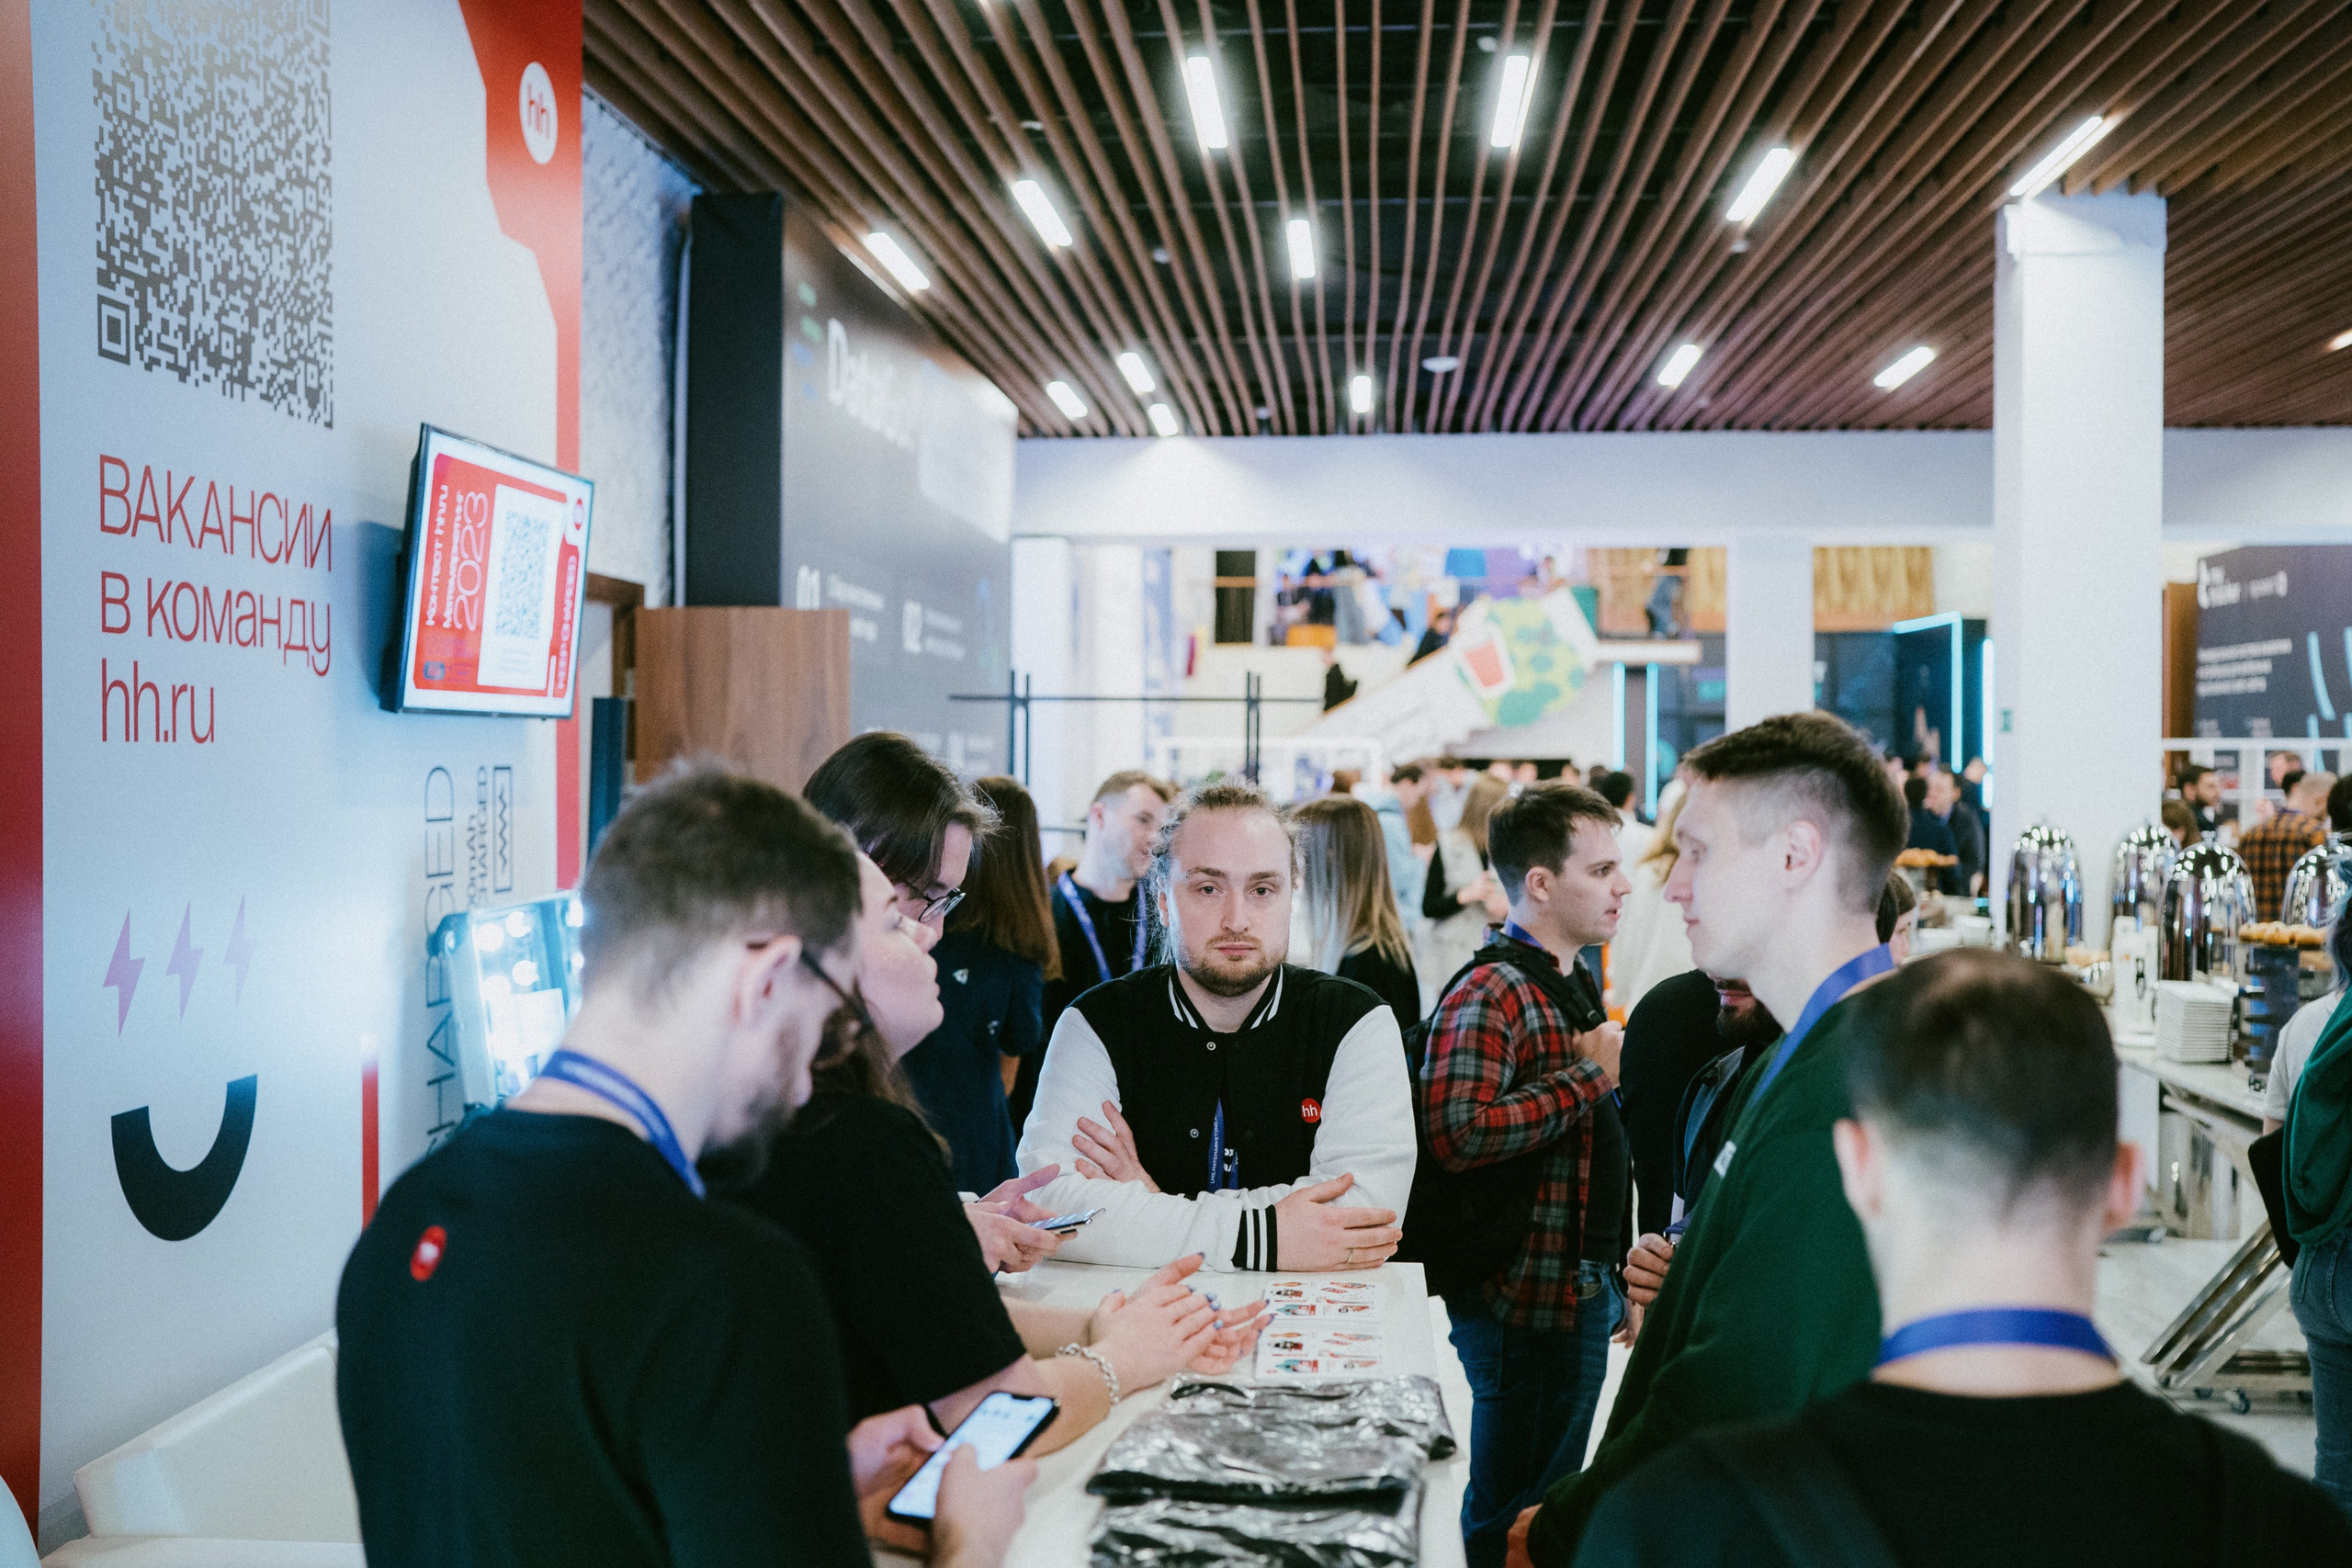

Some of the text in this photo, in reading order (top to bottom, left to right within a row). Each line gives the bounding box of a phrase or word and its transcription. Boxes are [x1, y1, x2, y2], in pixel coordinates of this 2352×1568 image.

[527, 83, 550, 141] hh
[99, 453, 333, 571] ВАКАНСИИ
[454, 491, 489, 632] 2023
[147, 579, 331, 677] команду
[101, 658, 214, 744] hh.ru
[1302, 1104, 1318, 1118] hh
